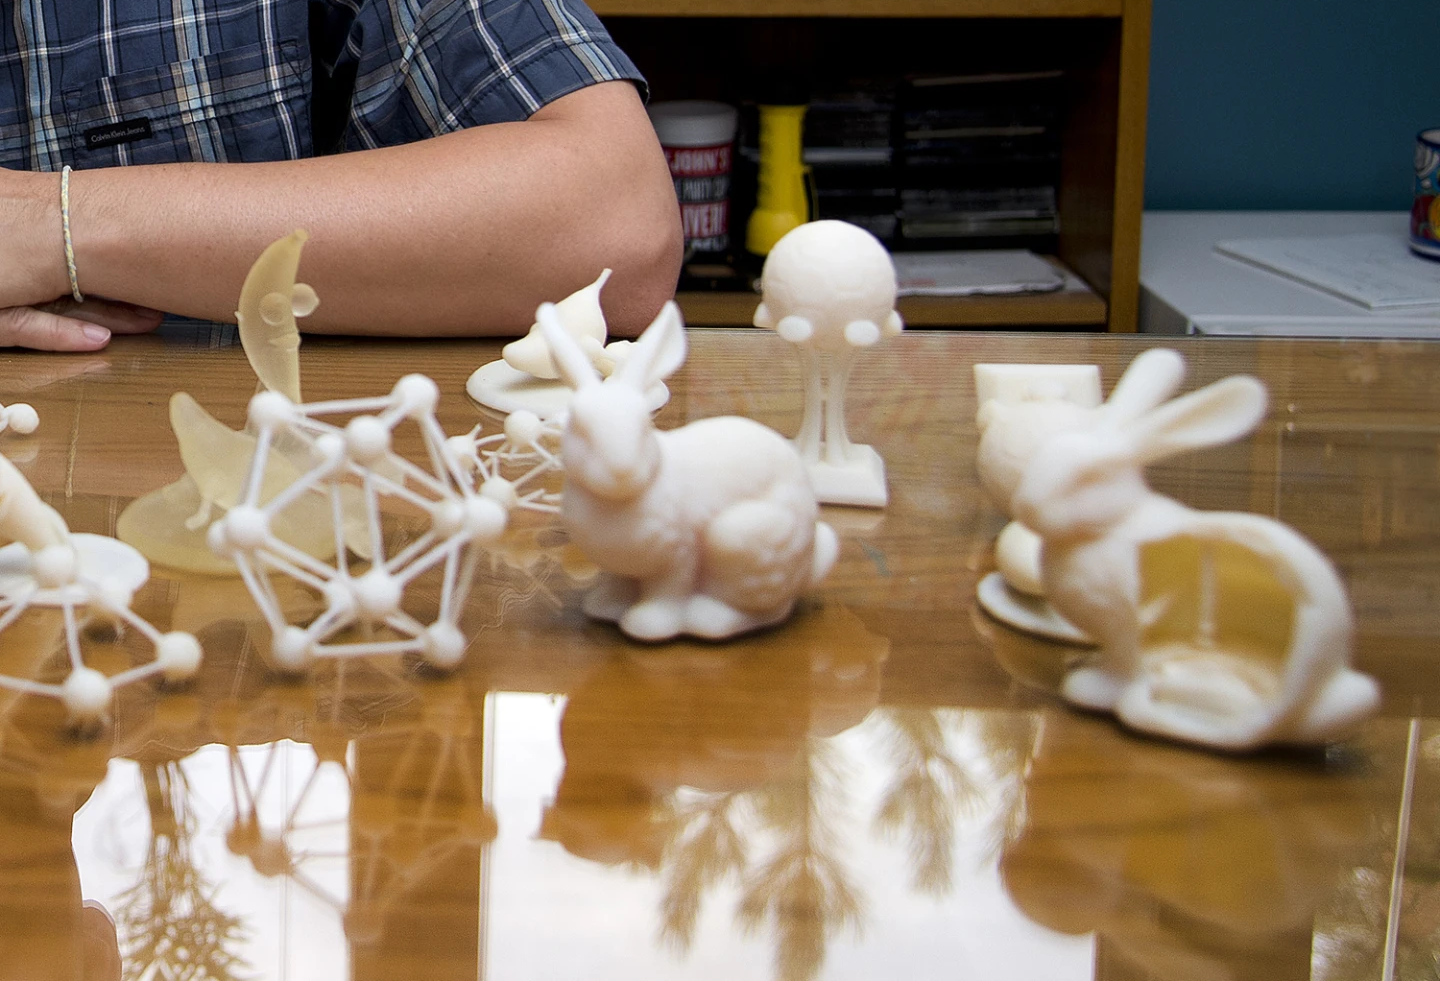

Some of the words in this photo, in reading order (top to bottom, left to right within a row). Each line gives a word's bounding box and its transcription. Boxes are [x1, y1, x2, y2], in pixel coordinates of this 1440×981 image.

[91, 132, 110, 143] Calvin
[110, 129, 126, 138] Klein
[126, 127, 145, 135] Jeans
